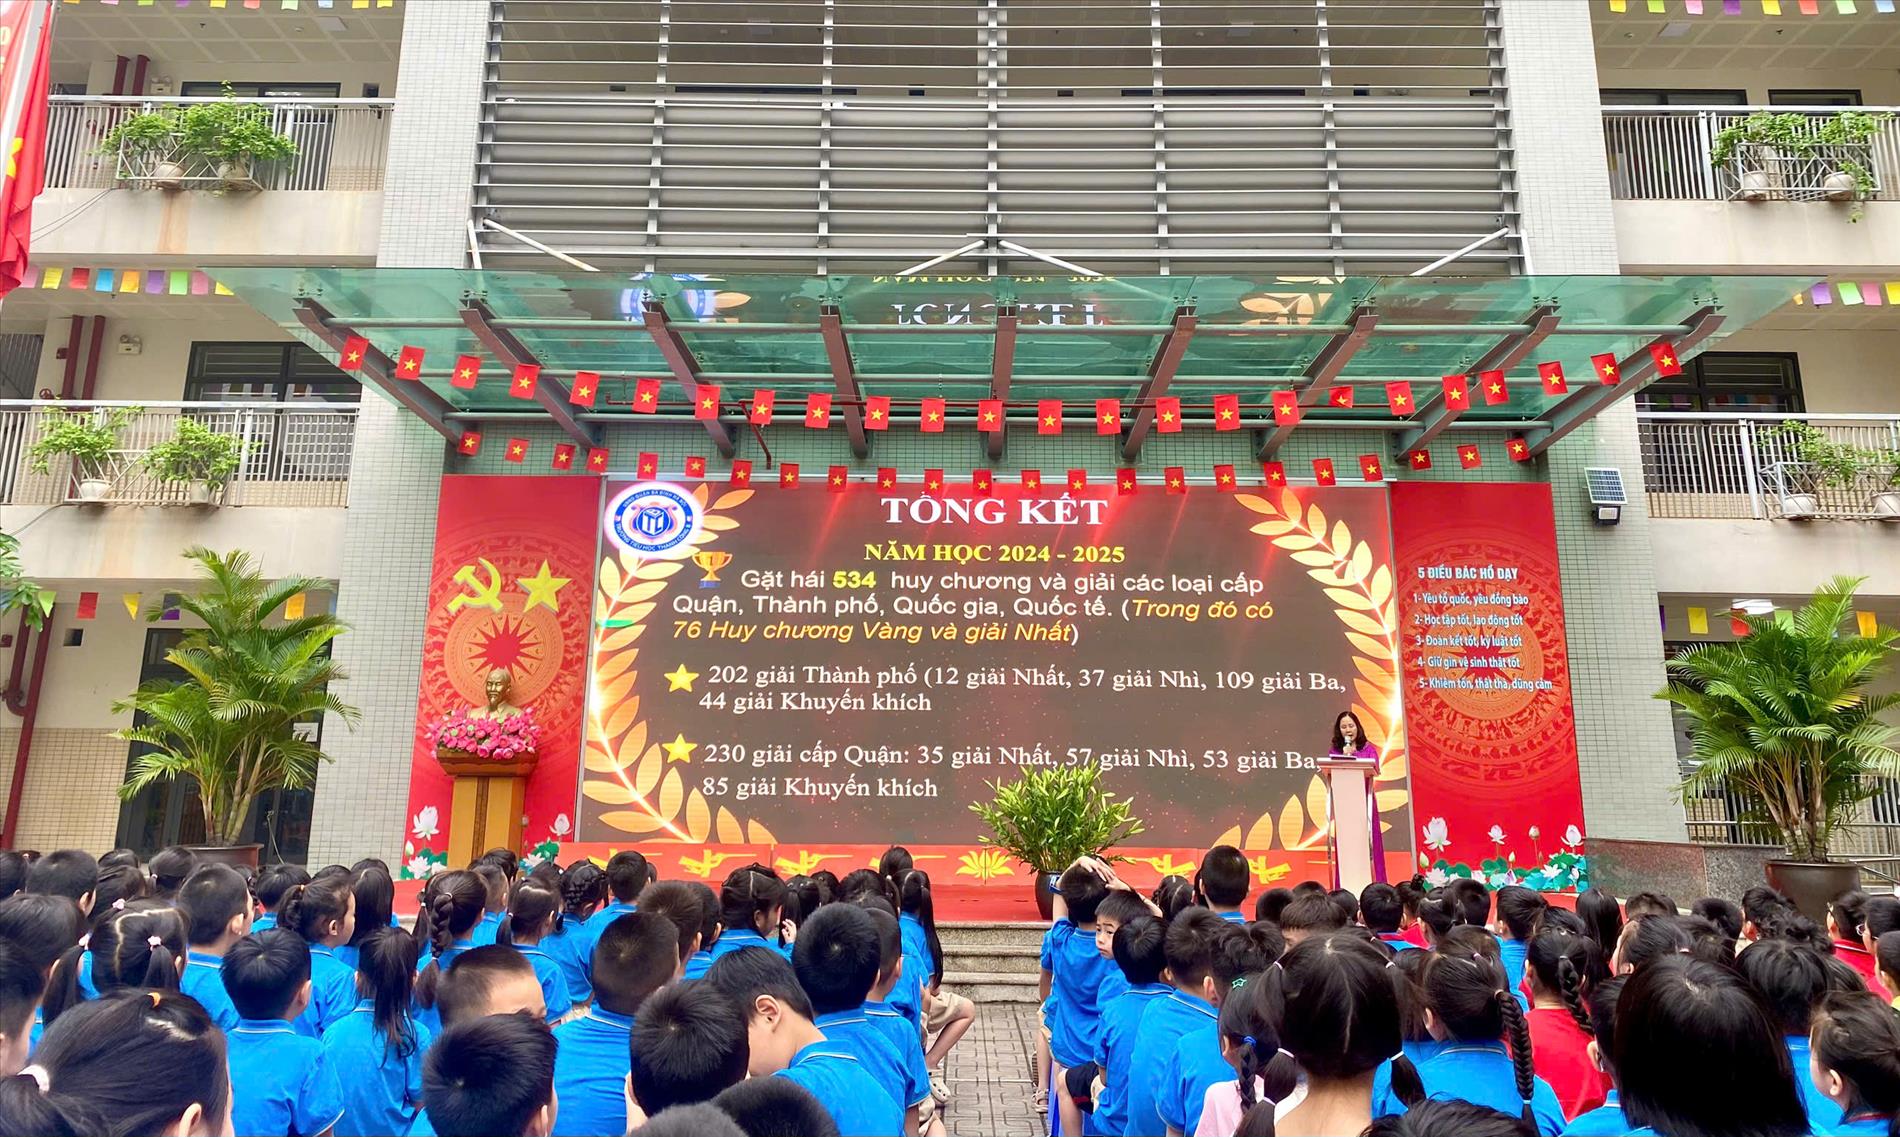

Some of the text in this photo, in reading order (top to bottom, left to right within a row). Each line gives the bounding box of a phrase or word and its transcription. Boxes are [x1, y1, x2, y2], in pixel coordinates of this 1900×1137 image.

[881, 491, 1108, 525] TỔNG KẾT
[864, 540, 926, 561] NĂM
[933, 544, 992, 565] HỌC
[998, 545, 1050, 561] 2024
[1073, 546, 1125, 562] 2025
[741, 570, 1263, 596] Gặt hái 534 huy chương và giải các loại cấp
[673, 593, 1273, 622] Quận, Thành phố, Quốc gia, Quốc tế. (Trong đó có
[673, 620, 1079, 646] 76 Huy chương Vàng và giải Nhất)
[708, 662, 1346, 693] 202 giải Thành phố (12 giải Nhất, 37 giải Nhì, 109 giải Ba,
[699, 690, 931, 715] 44 giải Khuyến khích
[705, 745, 745, 763] 230
[753, 745, 793, 767] giải
[800, 743, 837, 767] cấp
[844, 745, 908, 767] Quận:
[918, 746, 943, 763] 35
[951, 745, 991, 767] giải
[999, 743, 1058, 767] Nhất,
[1066, 748, 1092, 766] 57
[1100, 748, 1140, 771] giải
[1147, 749, 1195, 770] Nhì,
[1203, 750, 1228, 768] 53
[1237, 750, 1277, 773] giải
[702, 774, 937, 800] 85 giải Khuyến khích
